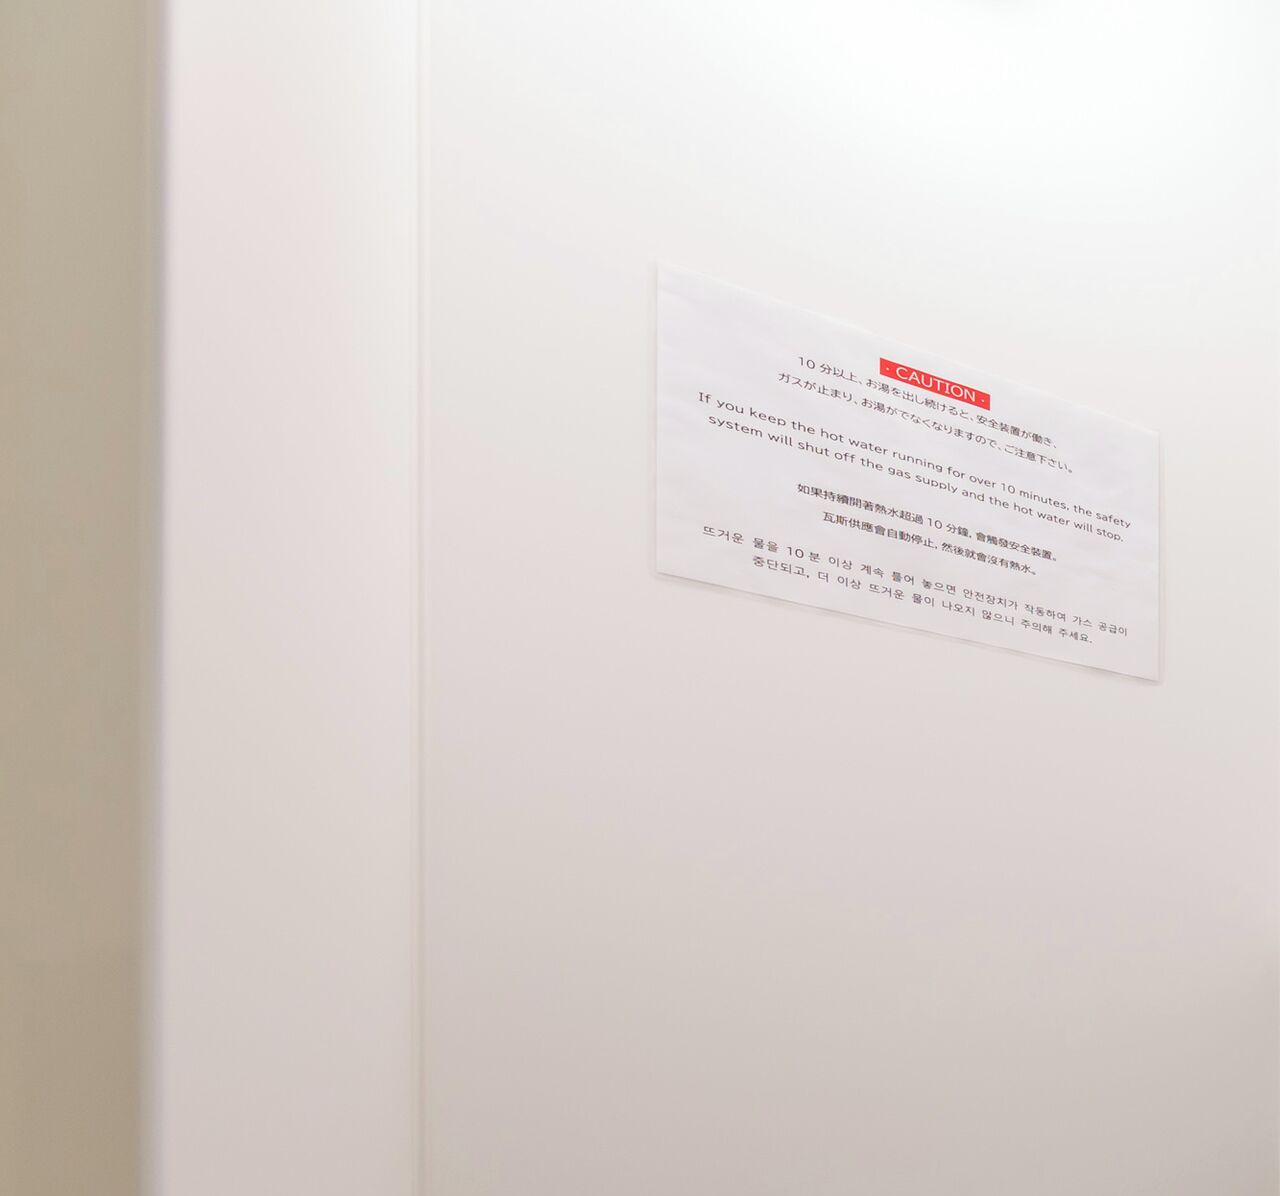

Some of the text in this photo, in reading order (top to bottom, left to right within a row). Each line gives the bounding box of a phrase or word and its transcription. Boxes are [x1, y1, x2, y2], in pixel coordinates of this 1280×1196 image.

[798, 356, 816, 370] 10
[896, 367, 976, 402] CAUTION
[699, 391, 712, 404] If
[717, 399, 744, 415] you
[750, 407, 786, 427] keep
[791, 420, 816, 435] the
[820, 427, 845, 443] hot
[849, 438, 888, 456] water
[892, 450, 943, 473] running
[947, 466, 966, 480] for
[969, 475, 997, 489] over
[1001, 483, 1016, 495] 10
[1073, 504, 1093, 517] the
[1096, 511, 1131, 529] safety
[708, 415, 1124, 542] system will shut off the gas supply and the hot water will stop.
[927, 517, 943, 530] 10
[703, 525, 744, 545] 뜨거운
[752, 537, 779, 553] 물을
[828, 556, 853, 571] 이상
[860, 563, 885, 579] 계속
[921, 578, 956, 596] 놓으면
[962, 588, 1018, 611] 안전장치가
[1024, 603, 1067, 622] 작동하여
[1072, 615, 1093, 628] 가스
[1098, 621, 1127, 637] 공급이
[752, 555, 1093, 643] 중단되고, 더 이상 뜨거운 물이 나오지 않으니 주의해 주세요.
